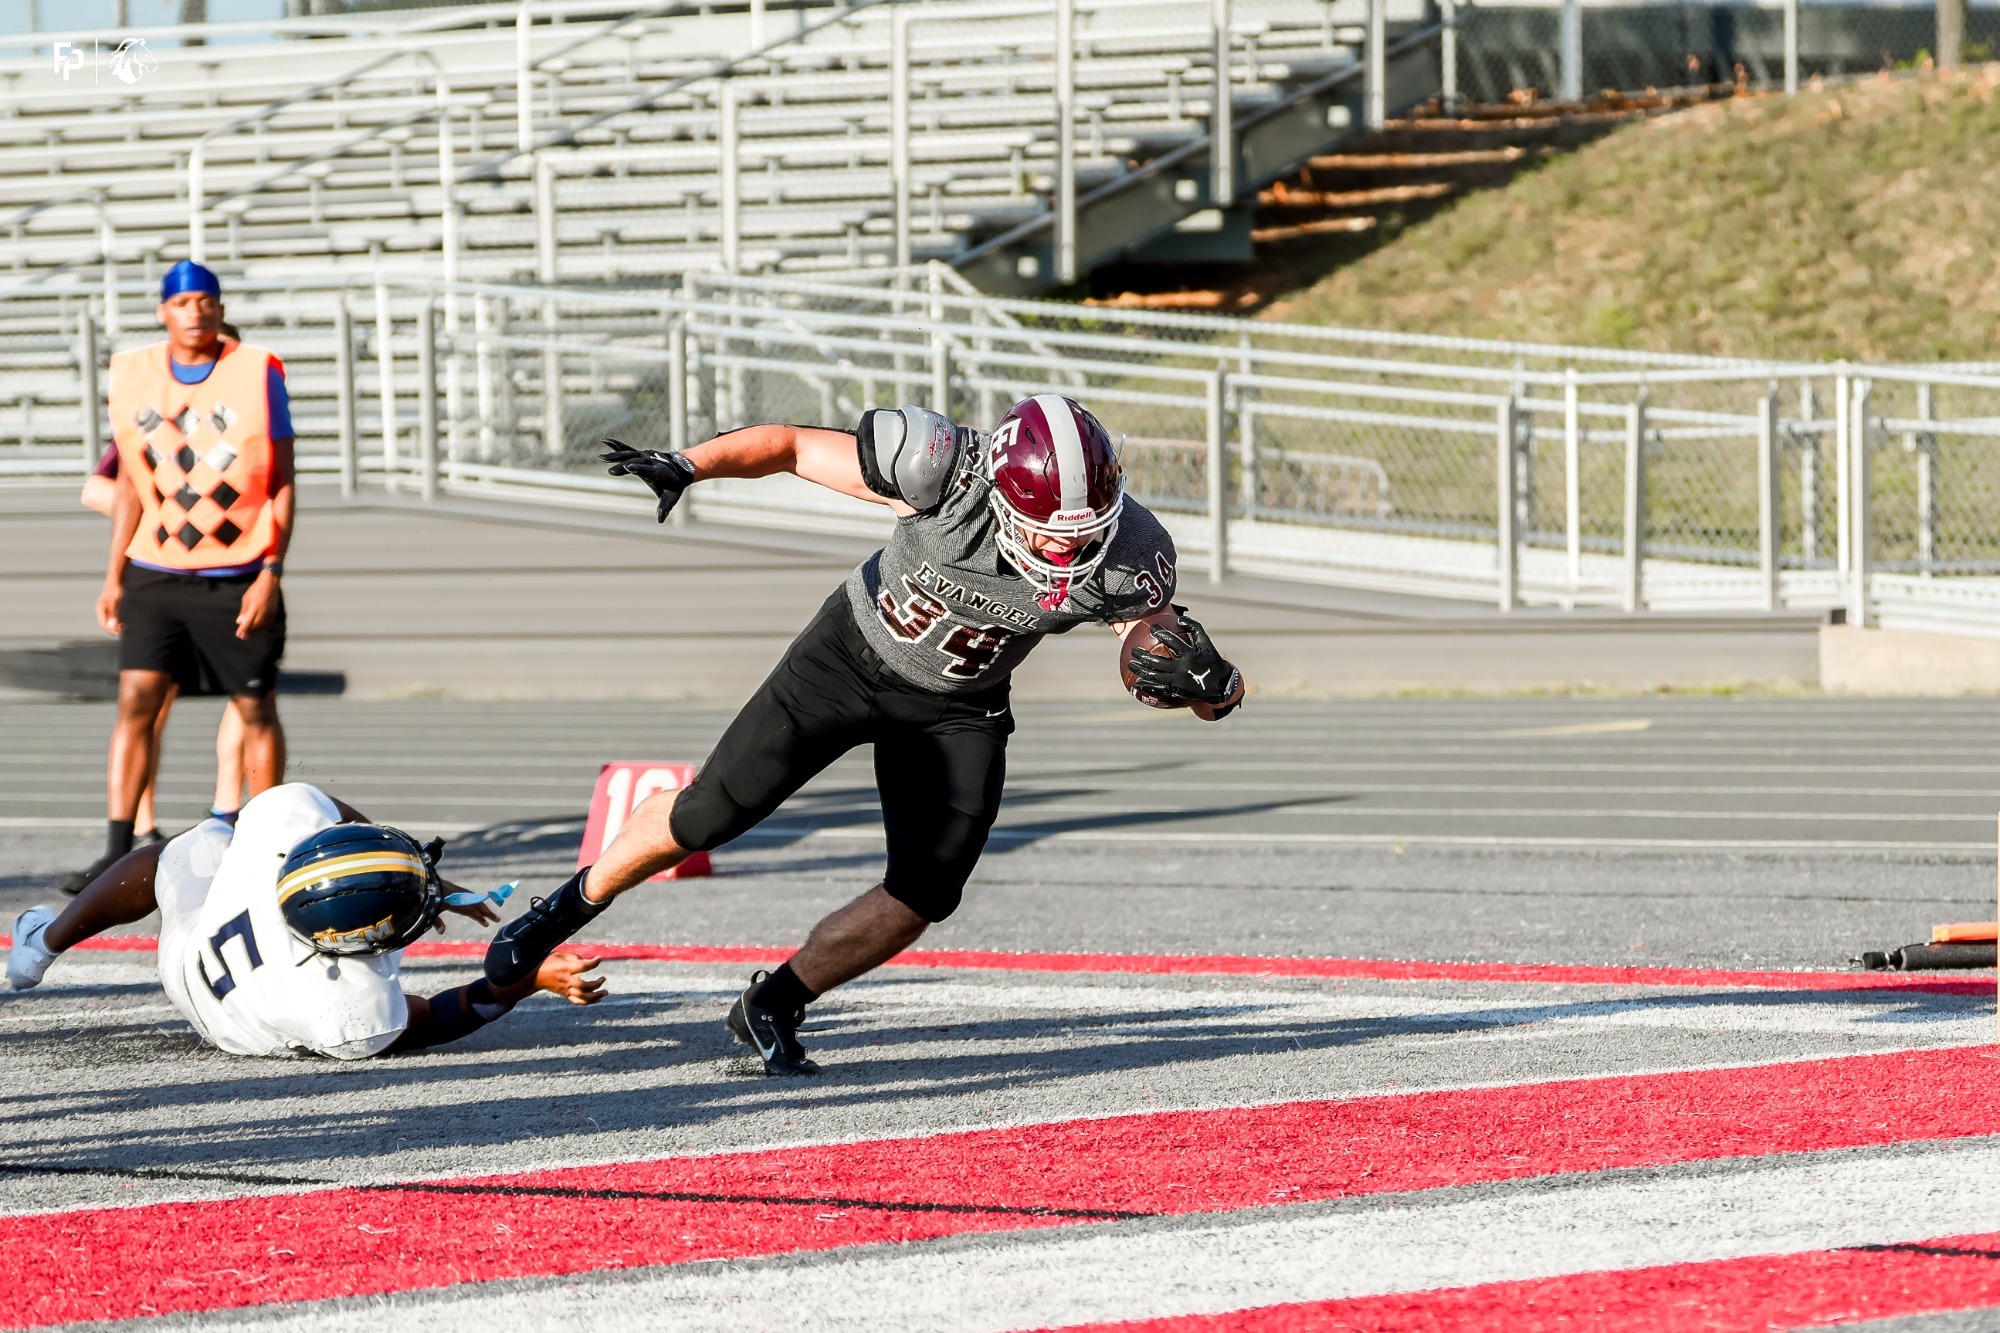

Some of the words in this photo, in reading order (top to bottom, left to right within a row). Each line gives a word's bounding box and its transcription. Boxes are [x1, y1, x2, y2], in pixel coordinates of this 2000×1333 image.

[1057, 511, 1094, 522] Riddell
[913, 560, 1041, 631] EVANGEL
[1134, 551, 1174, 608] 34
[876, 573, 1028, 679] 34
[198, 907, 264, 1002] 5
